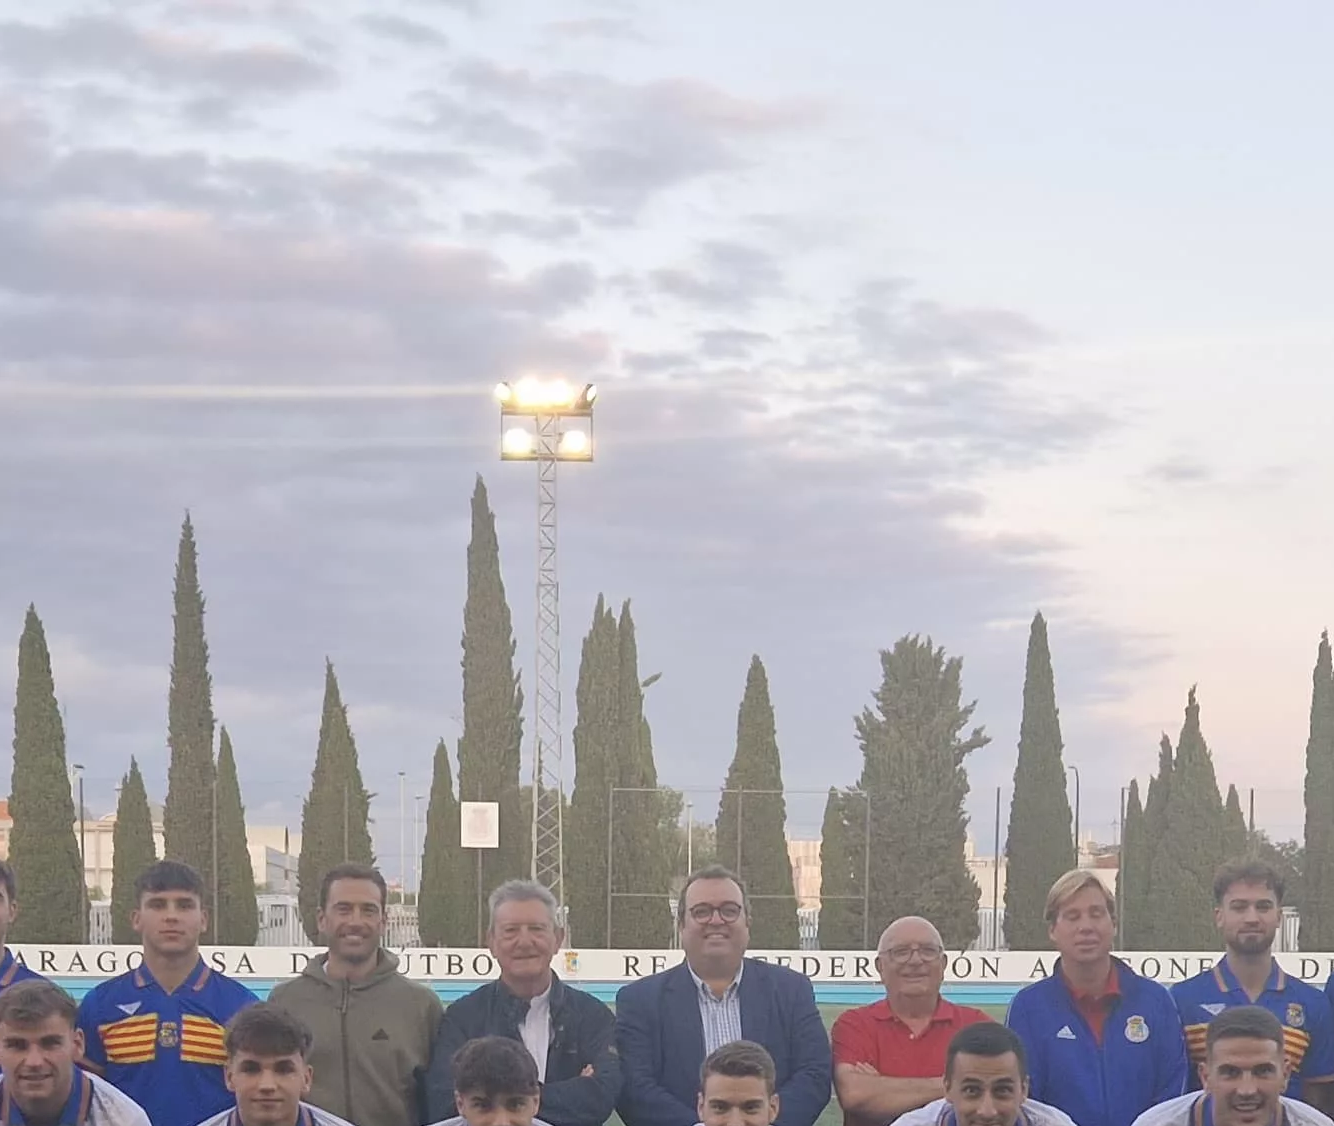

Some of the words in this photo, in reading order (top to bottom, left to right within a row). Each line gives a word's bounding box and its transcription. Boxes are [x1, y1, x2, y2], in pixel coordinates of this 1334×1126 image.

[14, 950, 255, 974] ARAGOSA
[399, 945, 493, 975] ÚTBO
[623, 955, 668, 976] RE
